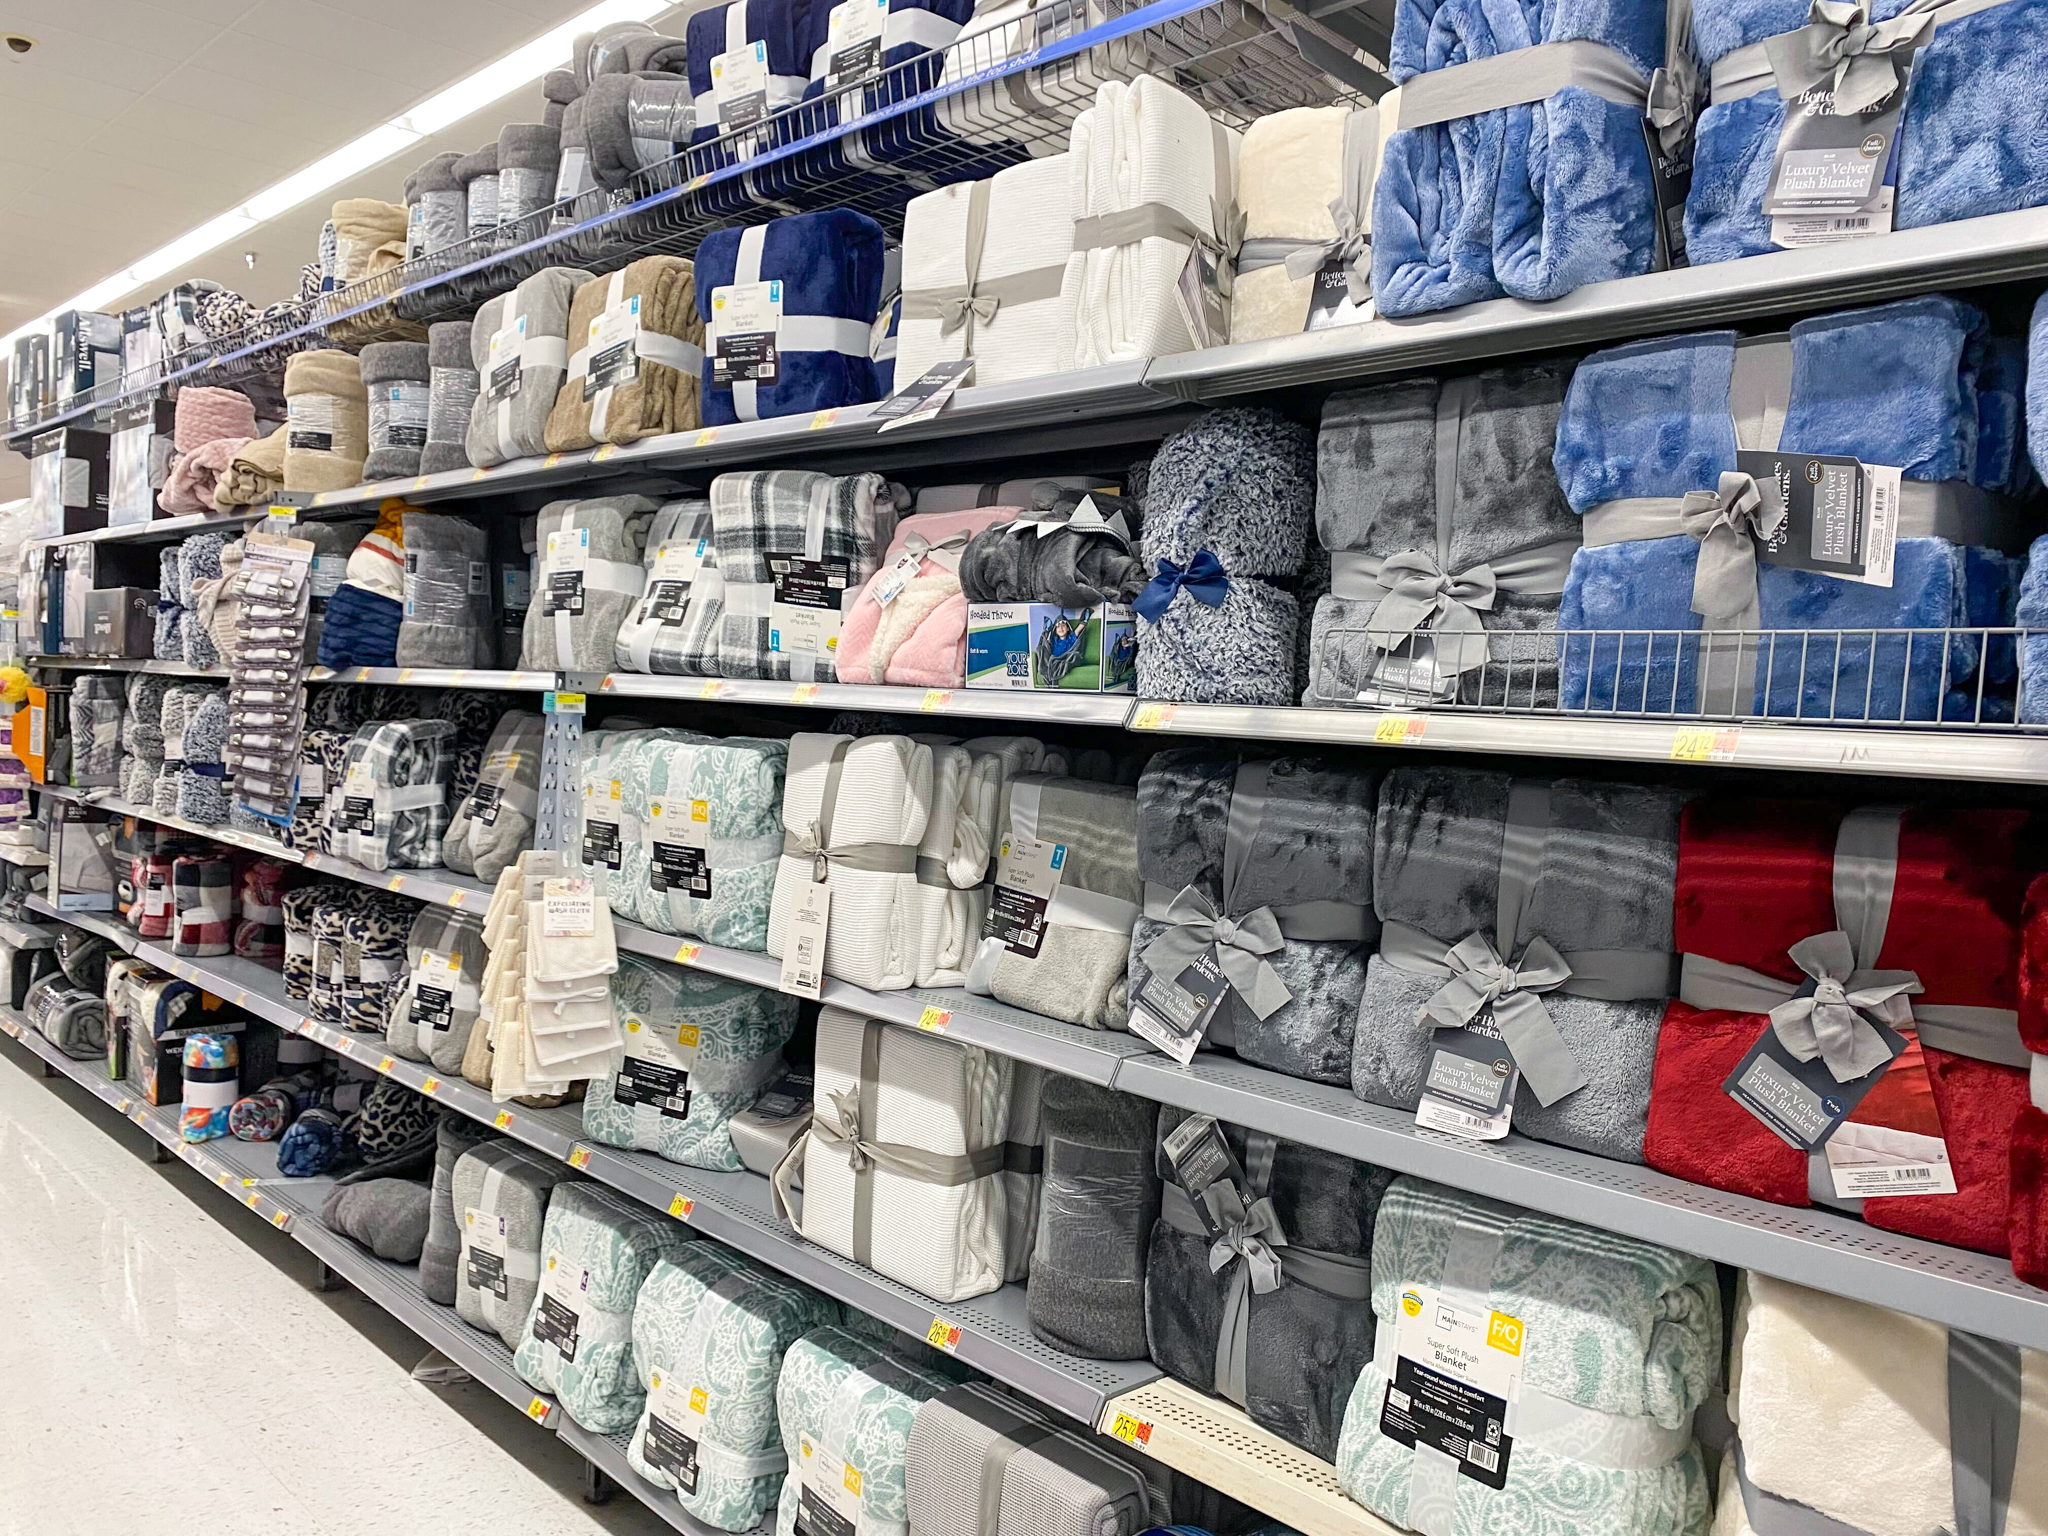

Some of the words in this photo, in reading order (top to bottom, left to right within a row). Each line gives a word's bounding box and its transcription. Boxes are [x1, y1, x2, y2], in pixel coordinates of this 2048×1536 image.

[894, 101, 917, 113] with
[918, 88, 946, 104] items
[948, 81, 965, 91] on
[965, 70, 985, 83] the
[987, 65, 1007, 80] top
[1007, 49, 1040, 71] shelf.
[1798, 90, 1834, 105] Bette
[1784, 164, 1828, 178] Luxury
[1832, 162, 1871, 175] Velvet
[1782, 178, 1816, 190] Plush
[1818, 175, 1866, 189] Blanket
[772, 284, 778, 295] T
[1824, 470, 1837, 508] Velvet
[1835, 472, 1849, 522] Blanket
[1822, 508, 1837, 556] Luxury
[1833, 521, 1846, 556] Plush
[969, 609, 991, 620] Hooded
[992, 608, 1014, 620] Throw
[1107, 607, 1124, 617] Hooded
[1005, 651, 1028, 664] YOUR
[1007, 664, 1029, 676] ZONE
[1056, 849, 1063, 862] T
[1009, 873, 1028, 885] Blanket
[548, 900, 593, 908] EXFOLIATING
[1147, 985, 1166, 1005] Plush
[1164, 1001, 1190, 1025] Blanket
[1151, 977, 1176, 1001] Luxury
[1174, 995, 1196, 1018] Velvet
[1432, 1071, 1459, 1088] Plush
[1458, 1081, 1496, 1101] Blanket
[1435, 1061, 1469, 1081] Luxury
[1470, 1071, 1500, 1090] Velvet
[1746, 1074, 1777, 1104] Plush
[1775, 1098, 1817, 1135] Blanket
[1753, 1064, 1793, 1101] Luxury
[1793, 1093, 1826, 1127] Velvet
[1825, 1097, 1842, 1115] Twin
[928, 1323, 943, 1344] 26
[1441, 1314, 1477, 1334] MAINSTAYS
[1491, 1318, 1520, 1345] F/Q
[1427, 1336, 1446, 1352] Super
[1446, 1344, 1461, 1356] Soft
[1461, 1349, 1480, 1365] Plush
[1434, 1350, 1468, 1372] Blanket
[1413, 1366, 1439, 1384] Year-round
[1438, 1377, 1459, 1392] warmth
[1463, 1388, 1486, 1403] comfort
